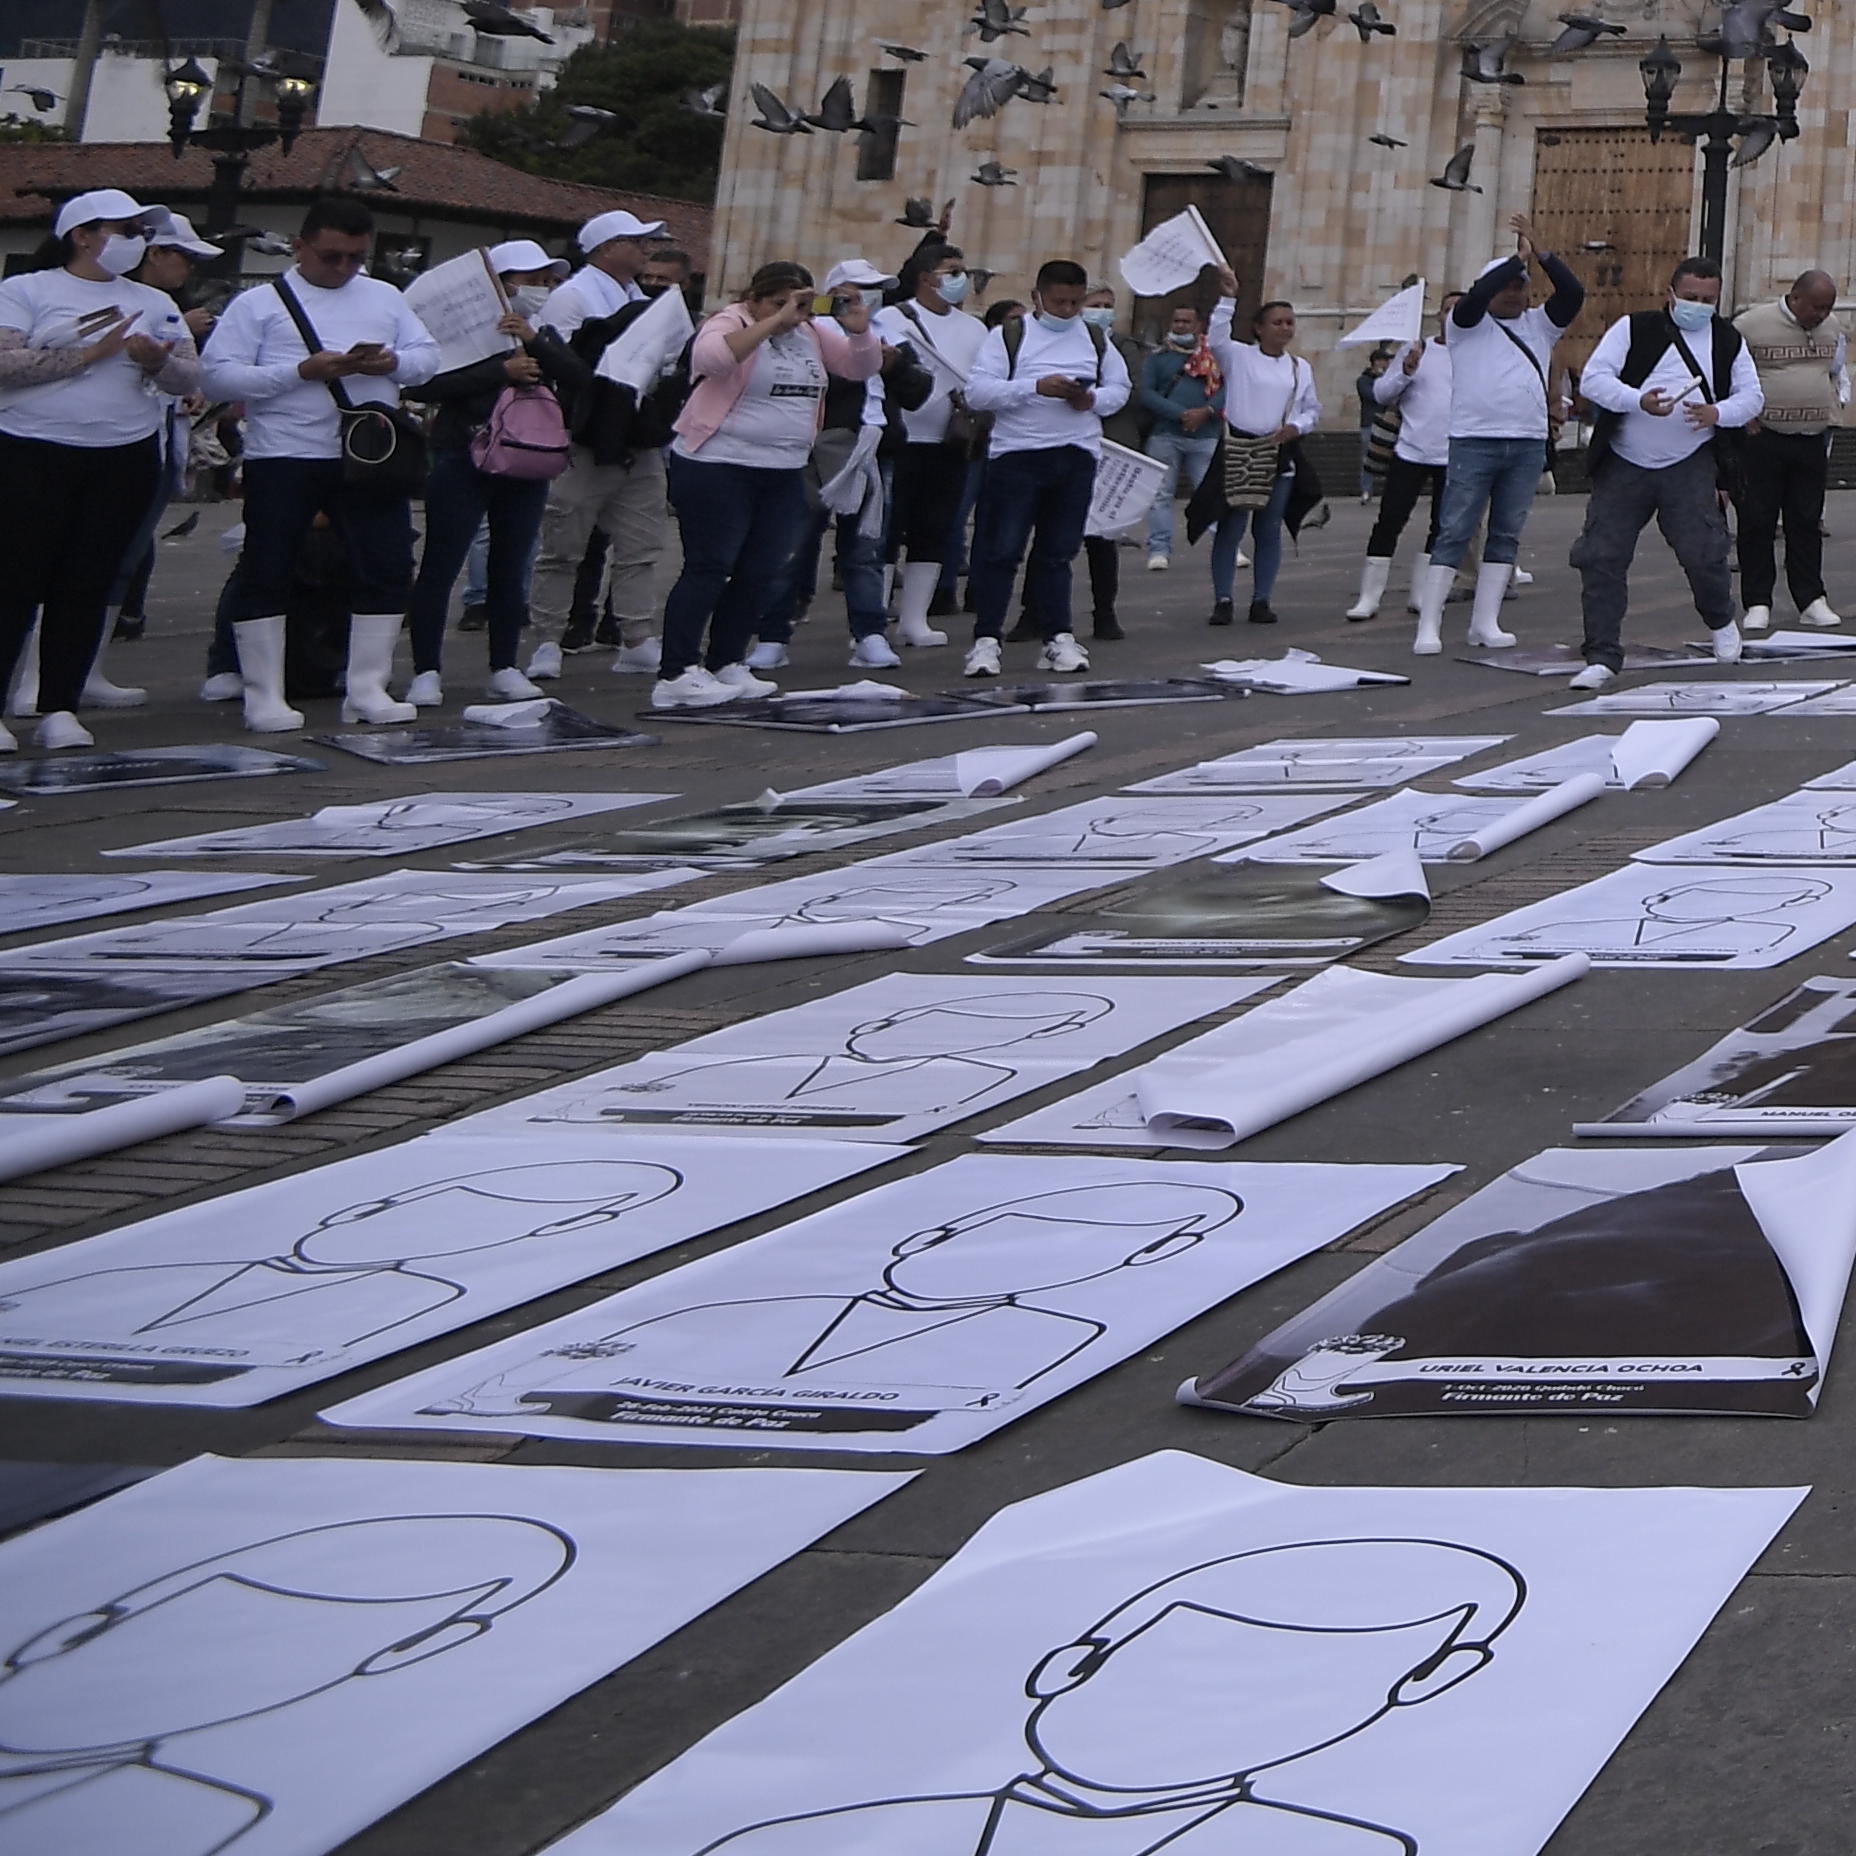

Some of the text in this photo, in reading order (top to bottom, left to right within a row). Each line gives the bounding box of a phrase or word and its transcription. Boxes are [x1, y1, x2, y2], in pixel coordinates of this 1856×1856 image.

[1760, 1109, 1831, 1118] MANUEL
[1419, 1363, 1704, 1374] URIEL VALENCIA OCHOA
[612, 1375, 902, 1402] JAVIER GARCÍA GIRALDO
[1440, 1391, 1624, 1402] Firmante de Paz
[610, 1410, 792, 1429] Firmante de Paz
